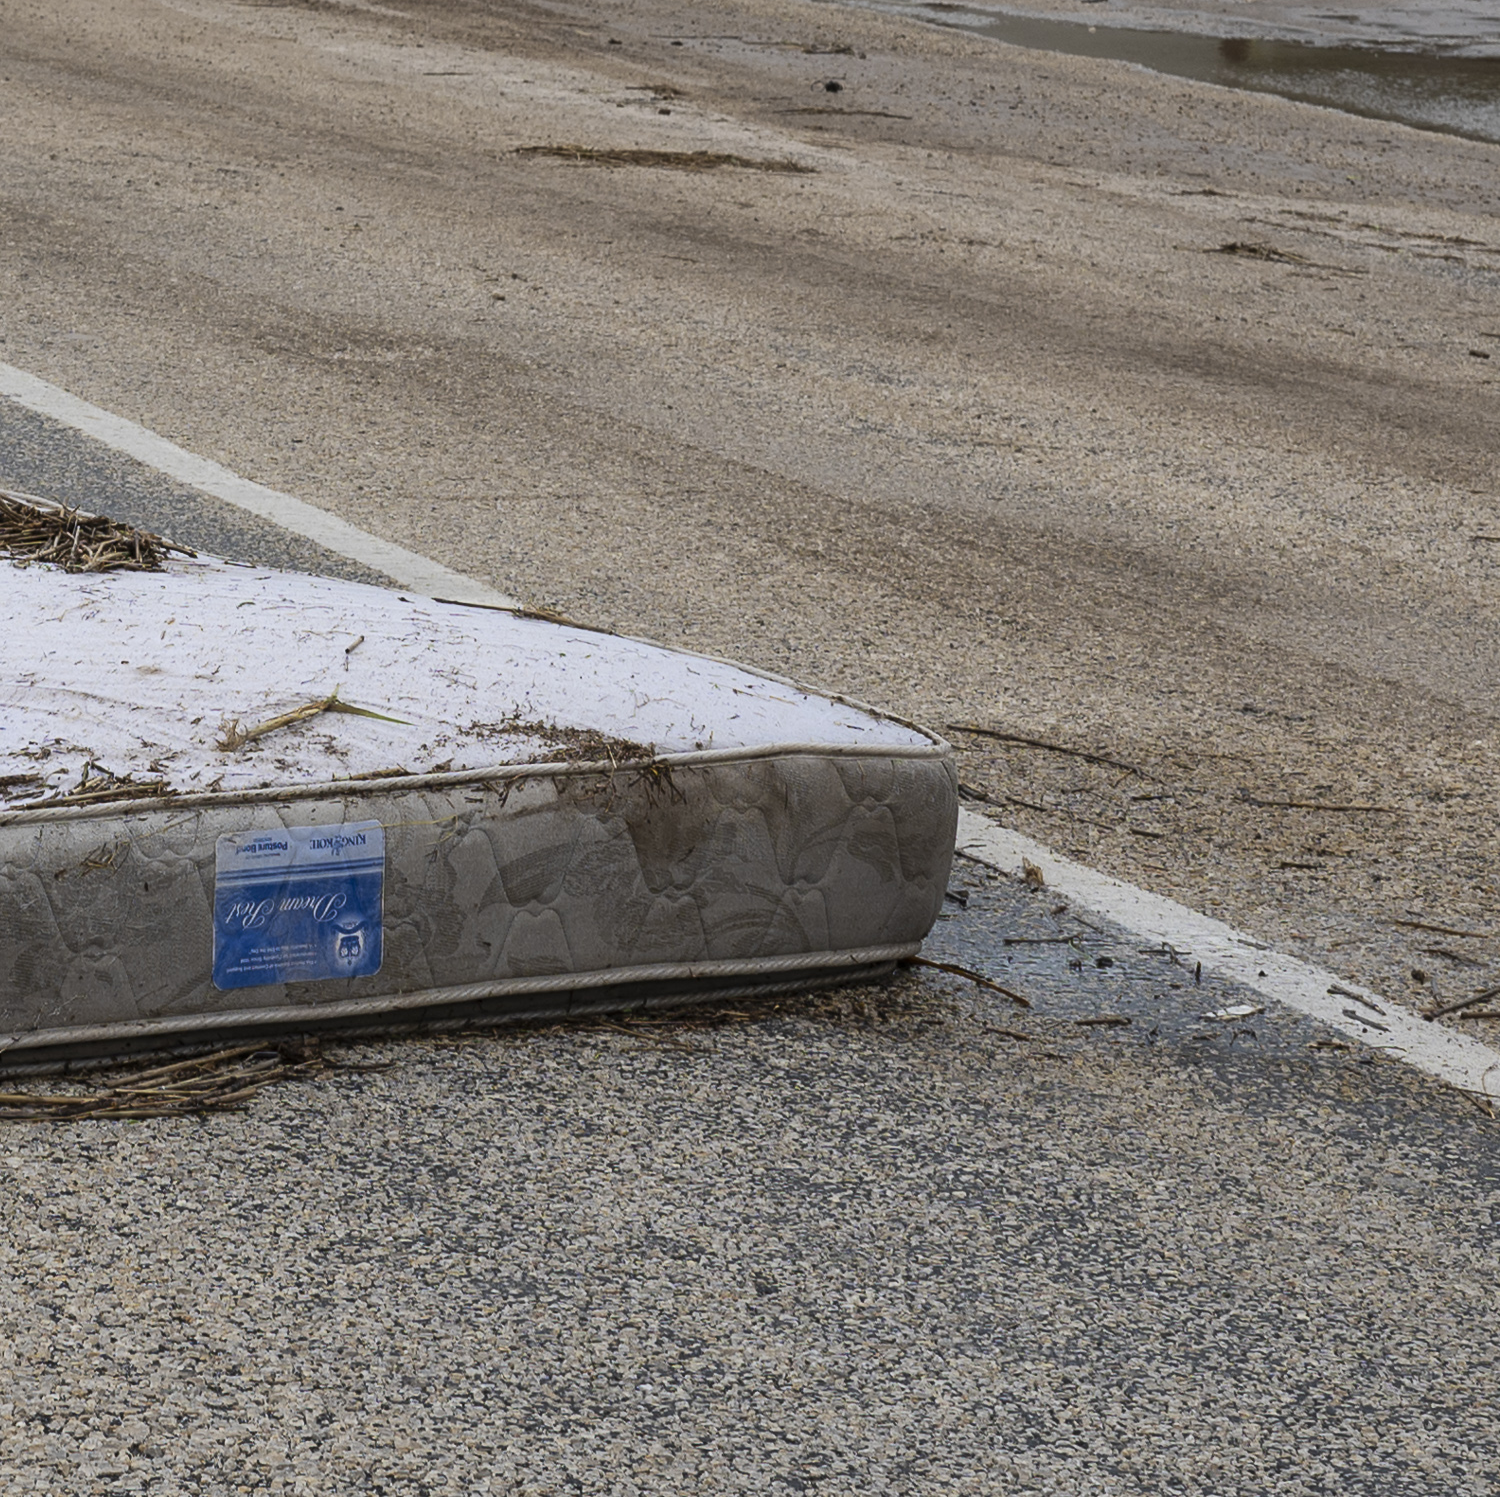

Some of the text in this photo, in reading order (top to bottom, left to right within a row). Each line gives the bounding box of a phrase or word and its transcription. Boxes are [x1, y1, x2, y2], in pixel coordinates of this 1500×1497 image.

[258, 841, 288, 852] Posture
[309, 833, 367, 850] KING KOIL
[225, 892, 347, 931] Dream Rest
